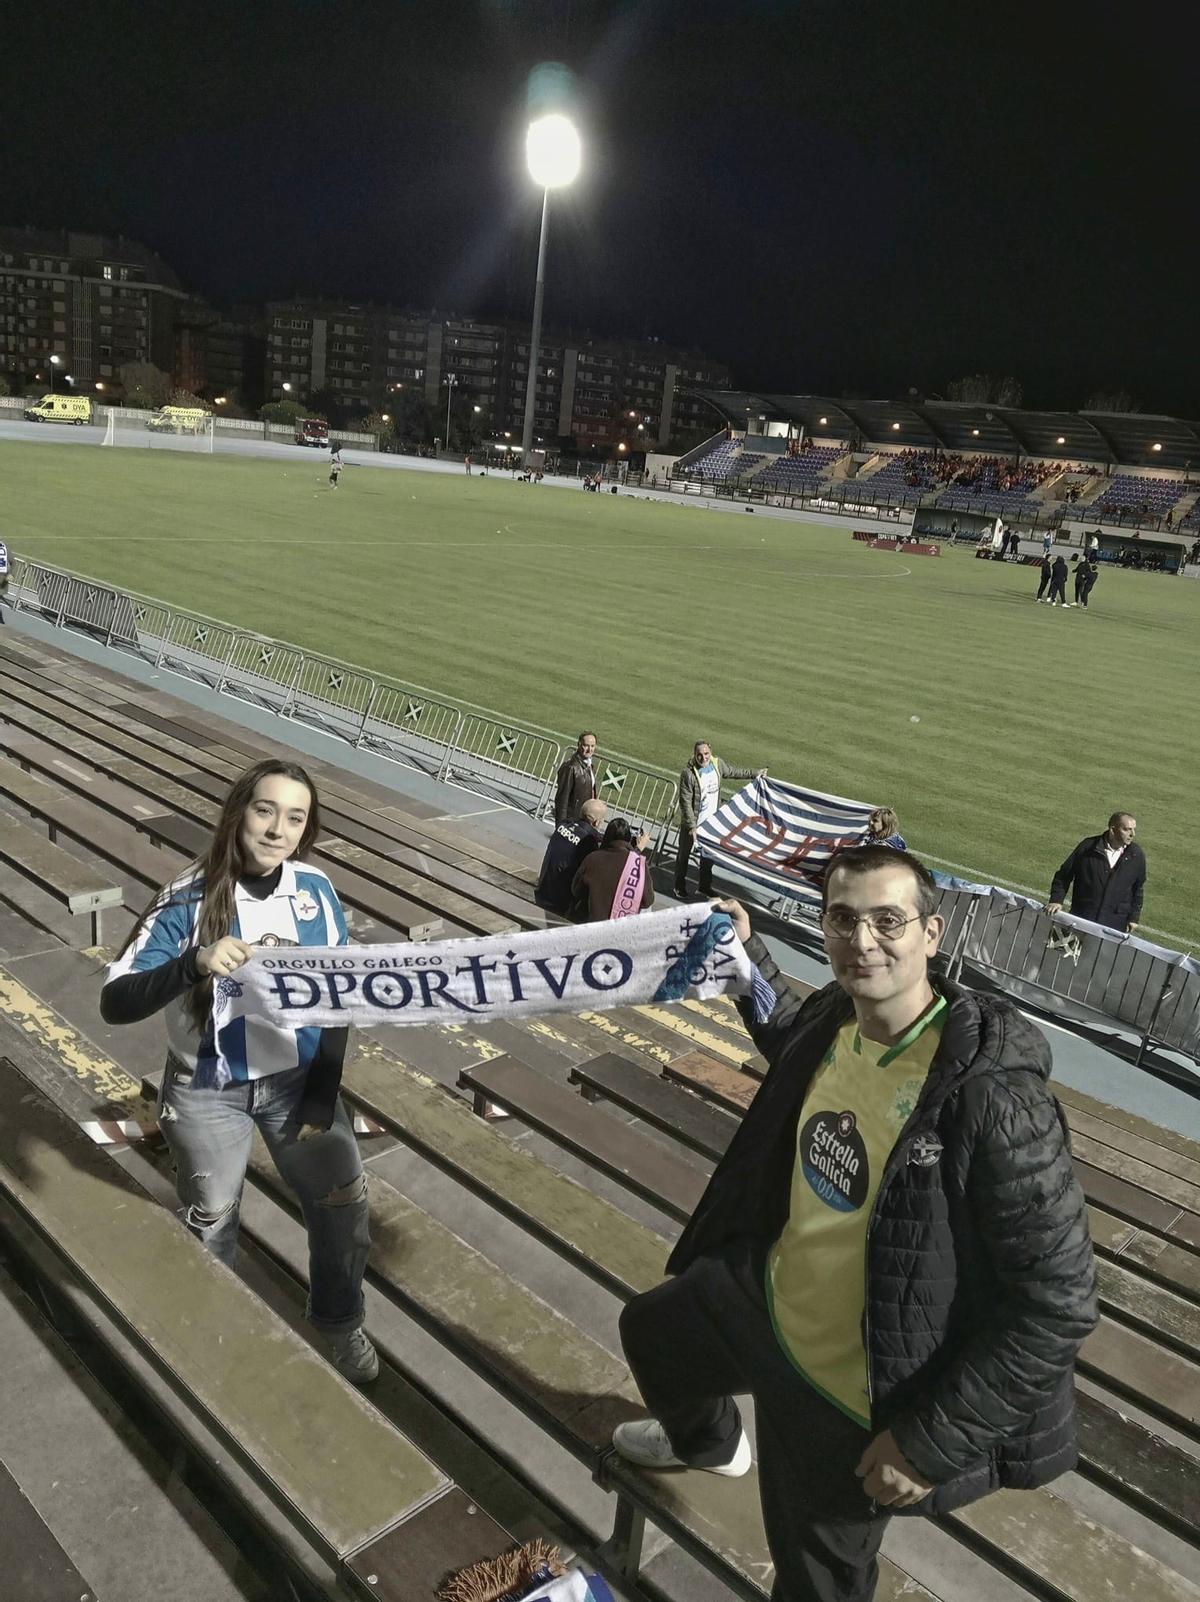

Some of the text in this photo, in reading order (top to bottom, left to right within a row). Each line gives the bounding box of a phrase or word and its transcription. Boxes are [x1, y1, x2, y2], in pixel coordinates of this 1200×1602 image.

[557, 825, 580, 846] DEPOR
[262, 955, 443, 971] ORGULLO GALEGO
[812, 1121, 859, 1176] Estrella
[809, 1142, 851, 1195] Galicia
